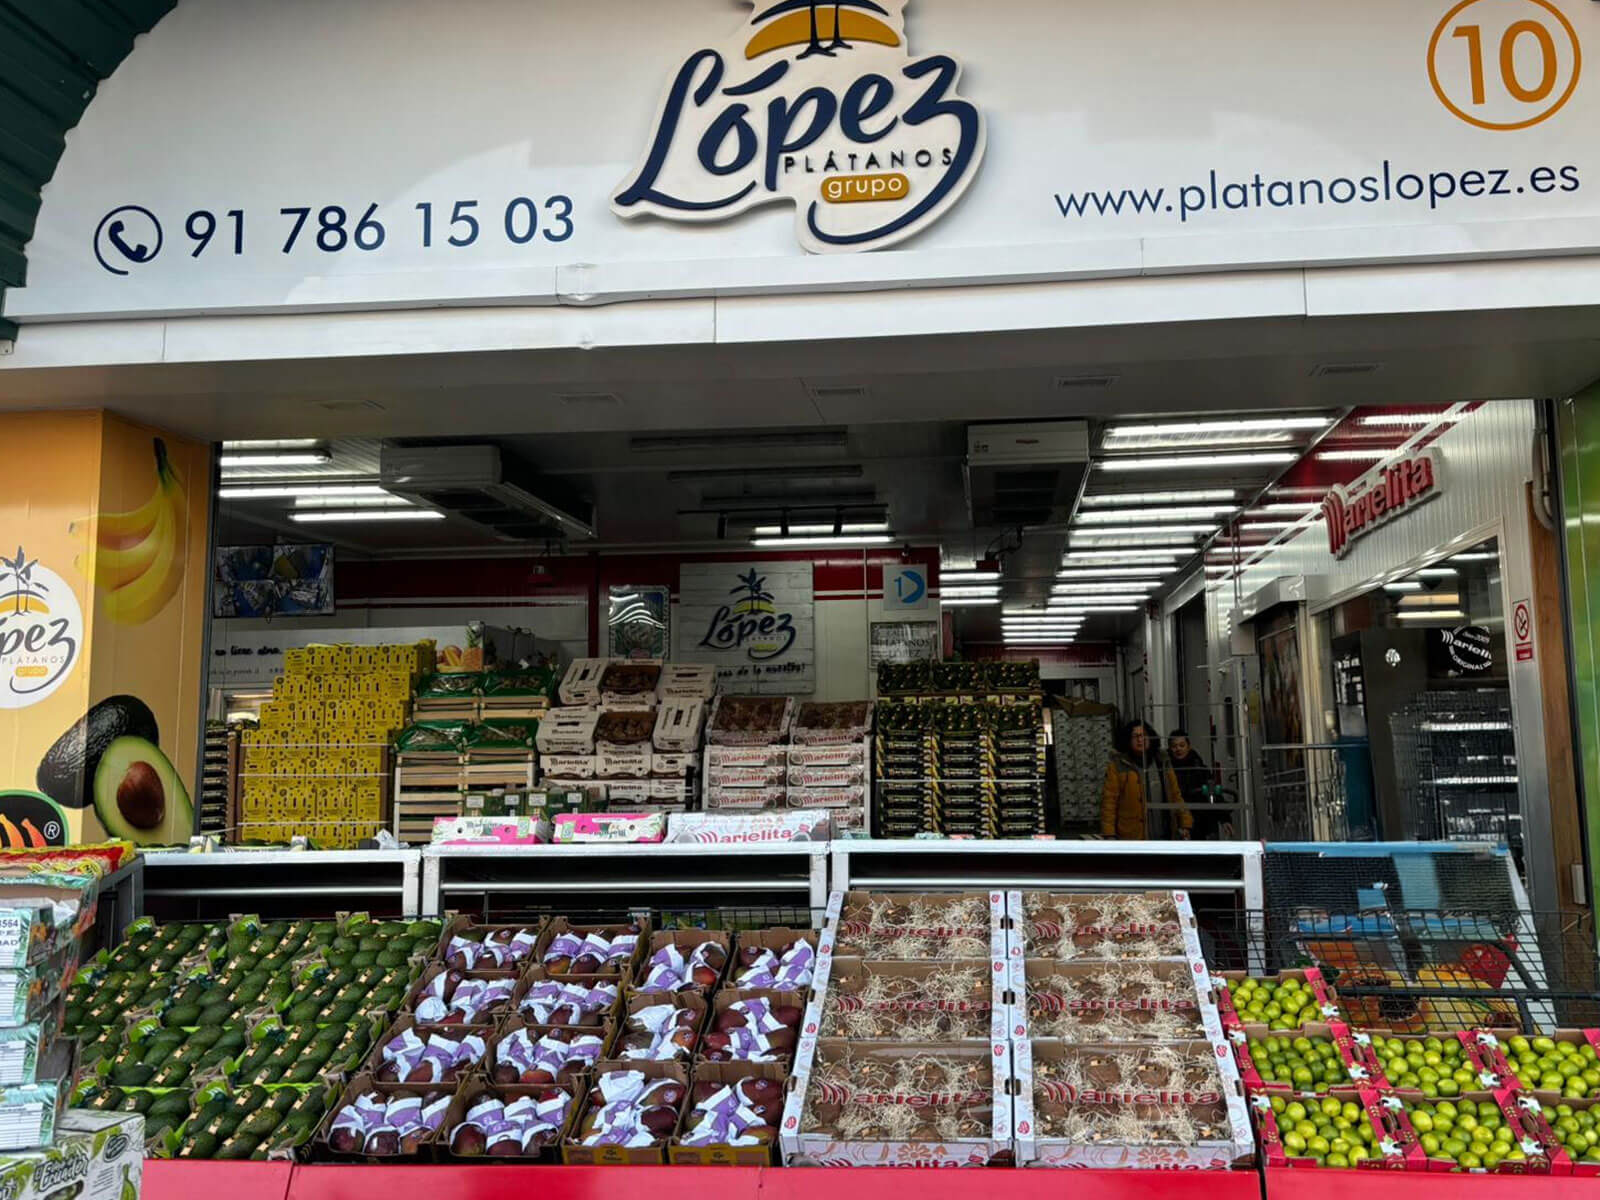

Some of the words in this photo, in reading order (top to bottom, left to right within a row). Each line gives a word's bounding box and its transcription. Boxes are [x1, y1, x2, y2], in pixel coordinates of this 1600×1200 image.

[1451, 19, 1558, 105] 10
[613, 48, 979, 245] López
[784, 147, 953, 173] PLÁTANOS
[827, 175, 903, 199] grupo
[1054, 160, 1581, 222] www.platanoslopez.es
[184, 209, 245, 257] 91
[280, 202, 386, 254] 786
[415, 200, 480, 248] 15
[503, 194, 575, 244] 03
[1038, 1080, 1220, 1106] Marielita
